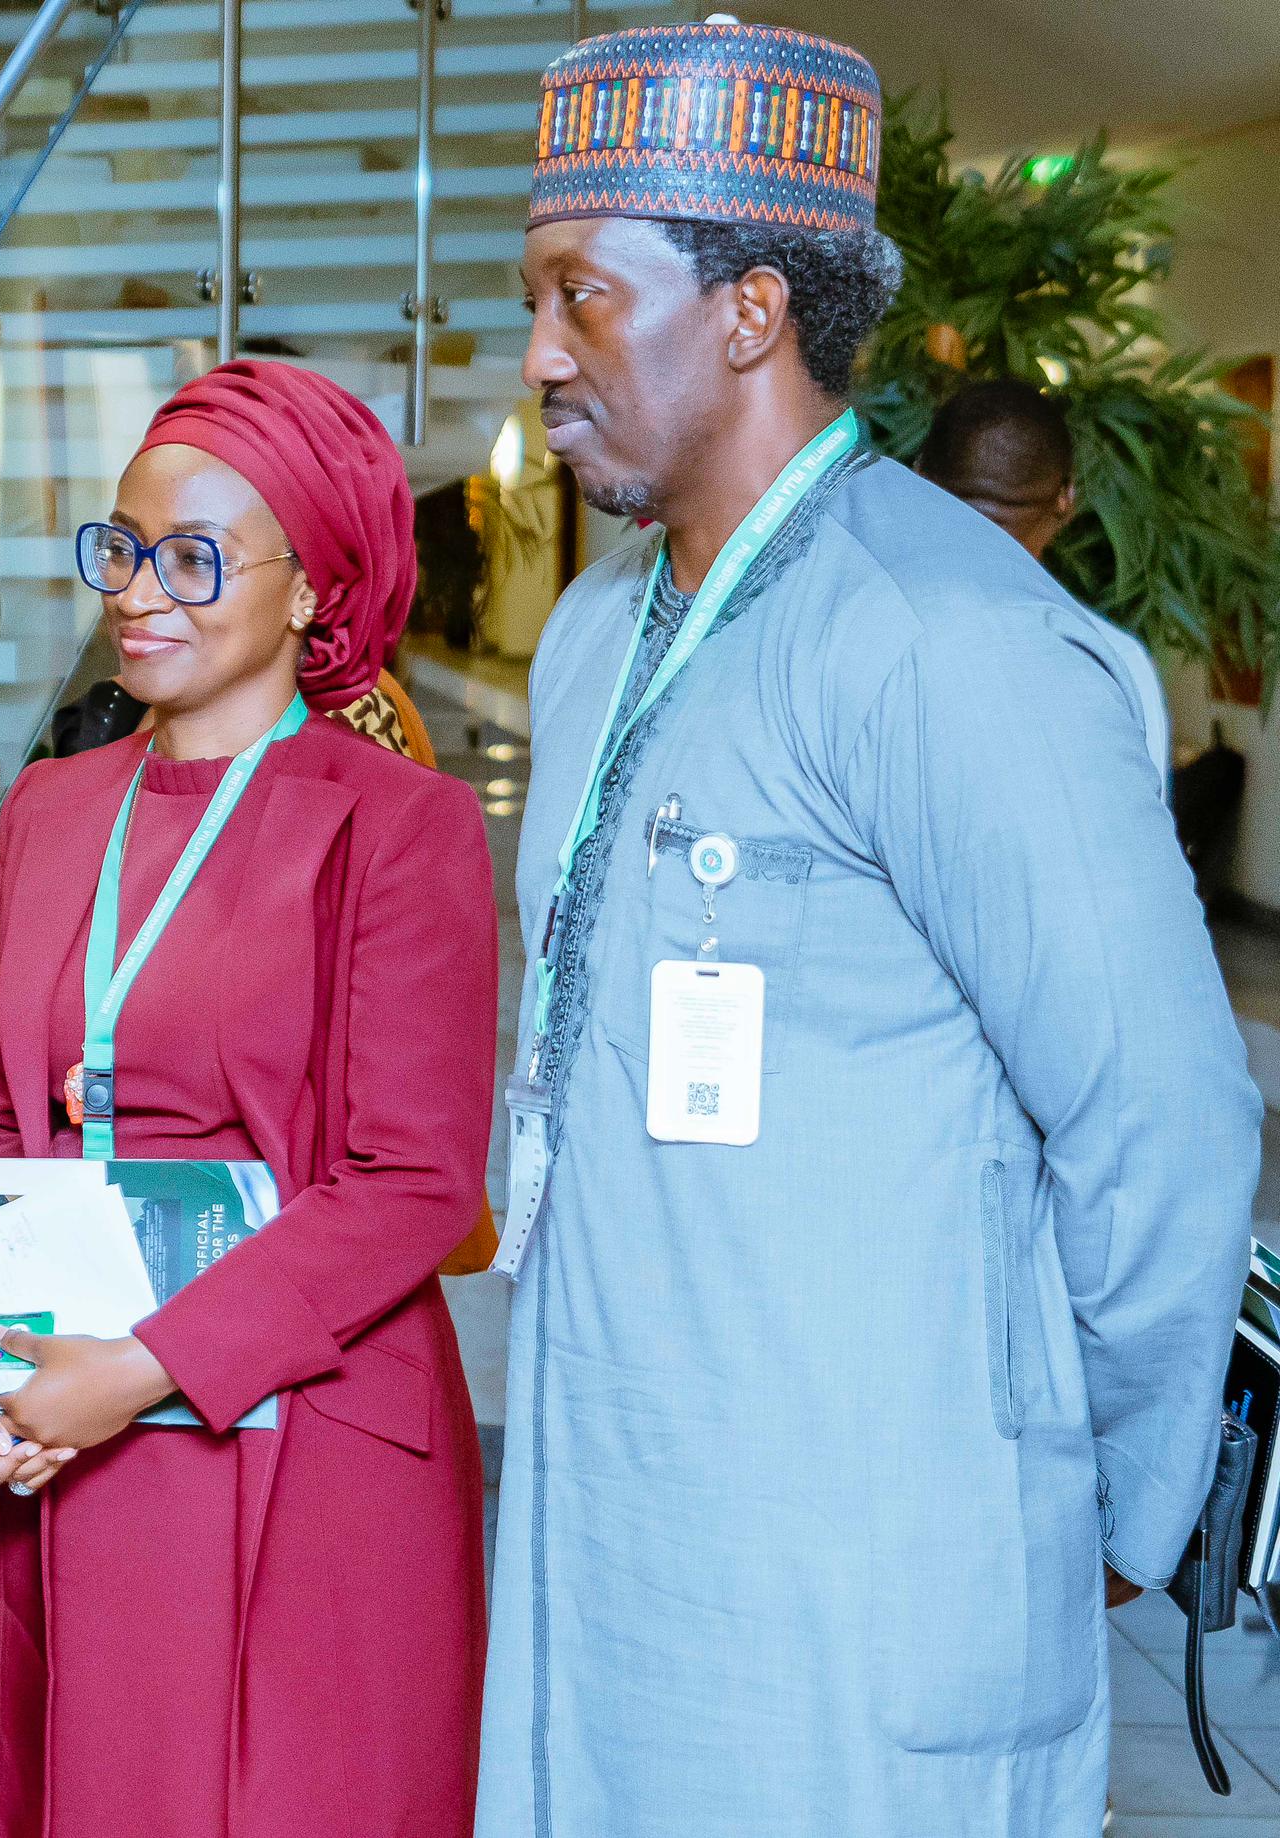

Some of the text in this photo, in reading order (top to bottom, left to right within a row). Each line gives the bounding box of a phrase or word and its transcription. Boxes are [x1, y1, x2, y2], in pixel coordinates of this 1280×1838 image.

[779, 469, 806, 496] VILLA
[750, 495, 785, 535] VISITOR
[701, 542, 752, 609] PRESIDENTIAL
[687, 611, 707, 640] VILLA
[173, 769, 243, 887] PRESIDENTIAL VILLA VISITOR
[100, 897, 169, 1014] PRESIDENTIAL VILLA VISITOR
[212, 1204, 224, 1263] OR THE
